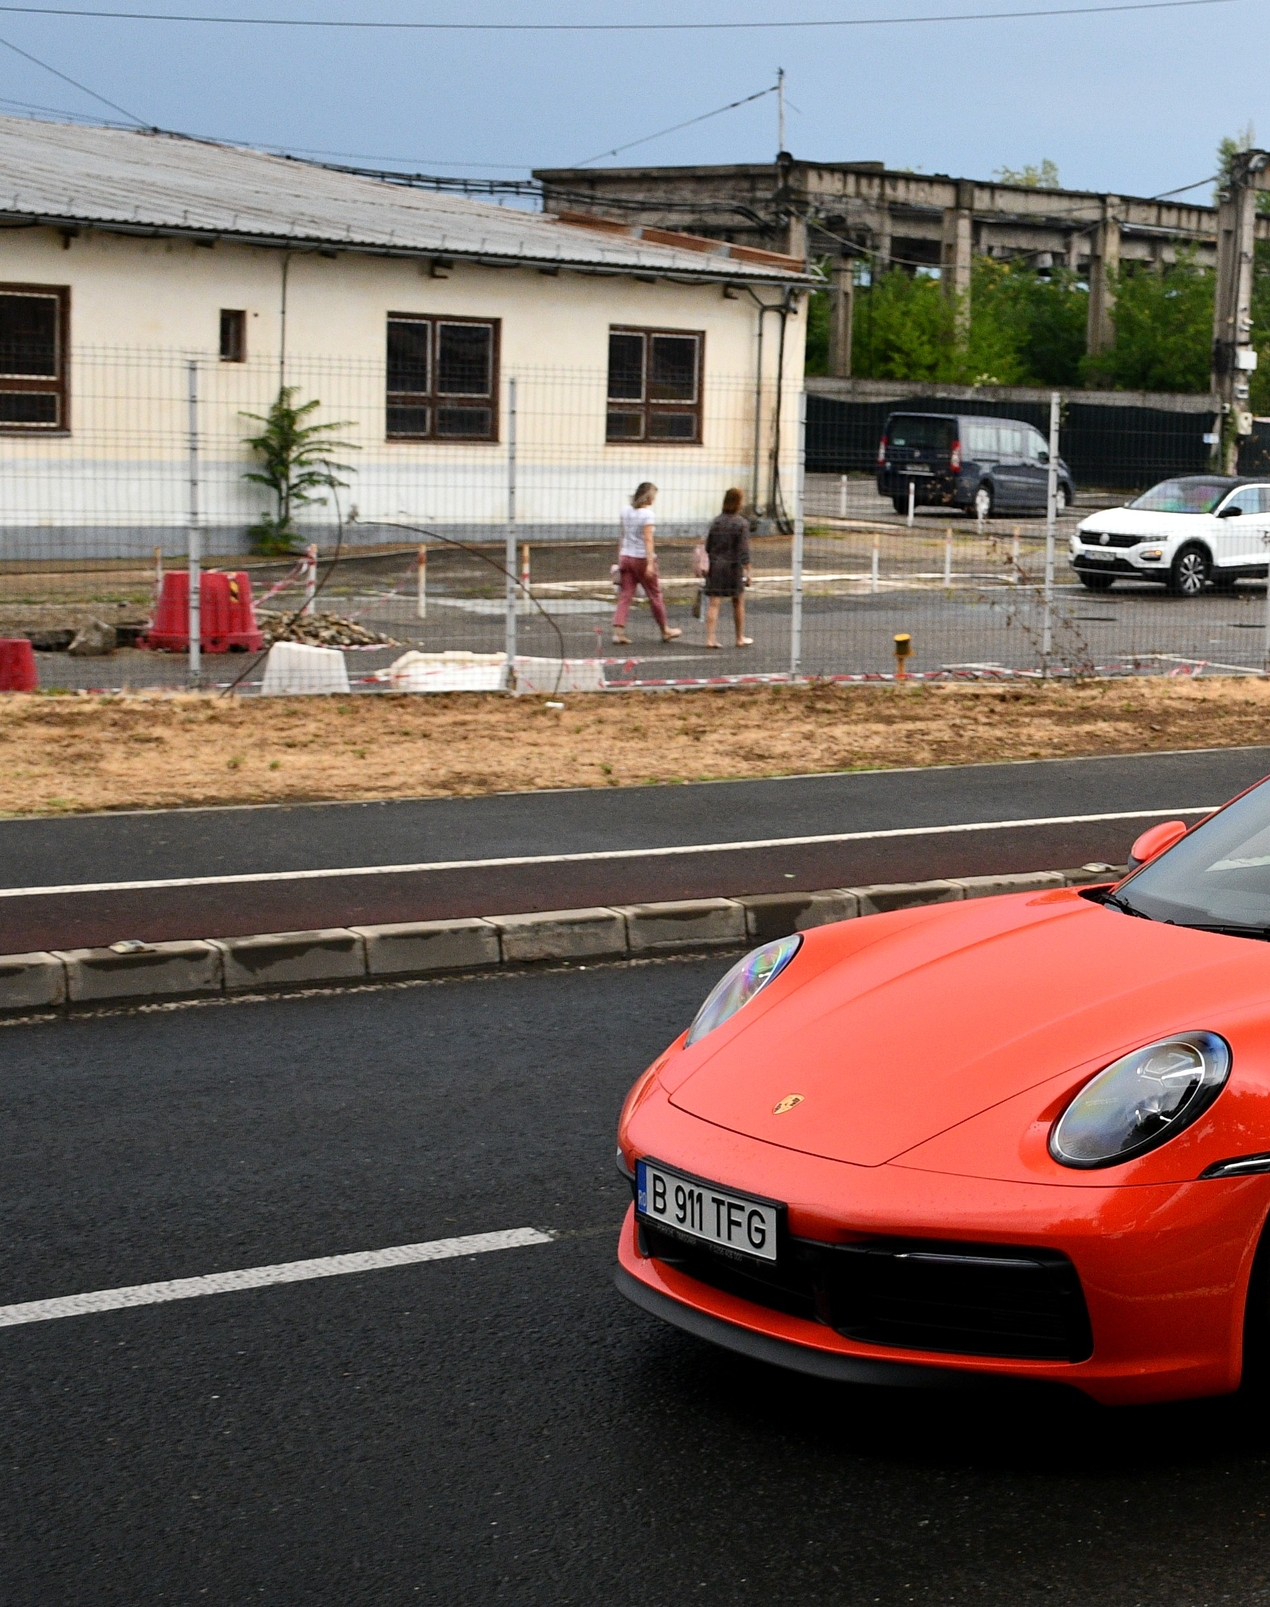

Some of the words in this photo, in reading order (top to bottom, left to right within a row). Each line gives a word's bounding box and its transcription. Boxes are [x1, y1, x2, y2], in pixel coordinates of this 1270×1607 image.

[653, 1173, 667, 1214] B
[674, 1184, 703, 1232] 911
[711, 1196, 766, 1249] TFG
